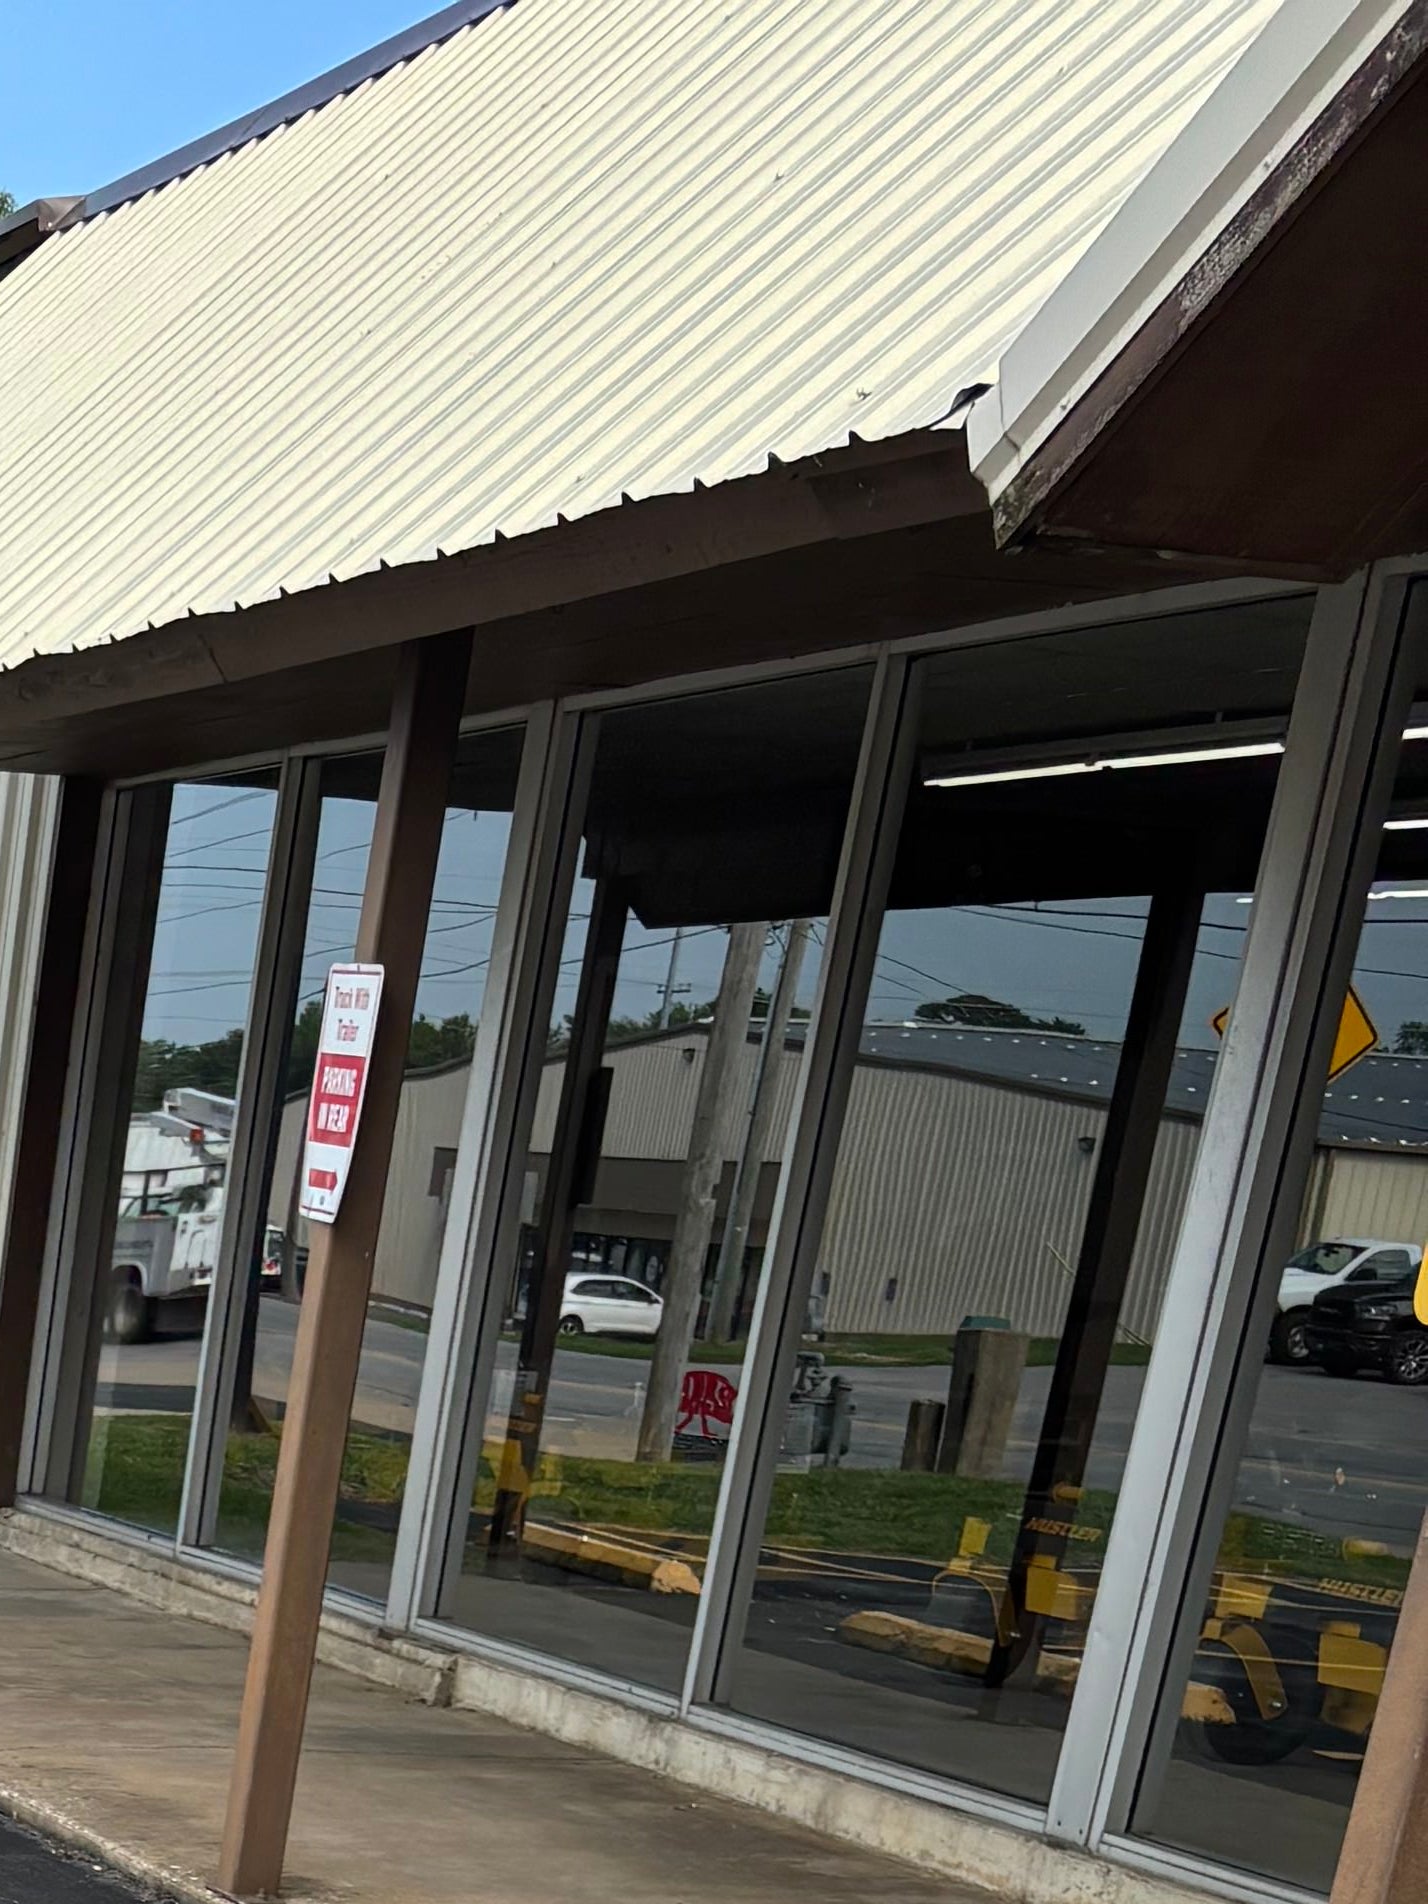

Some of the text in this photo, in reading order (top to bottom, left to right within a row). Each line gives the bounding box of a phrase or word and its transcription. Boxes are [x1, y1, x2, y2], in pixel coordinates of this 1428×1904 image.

[323, 1066, 357, 1097] PARKING
[328, 1104, 350, 1133] REAR
[1025, 1517, 1103, 1542] HUSTLER
